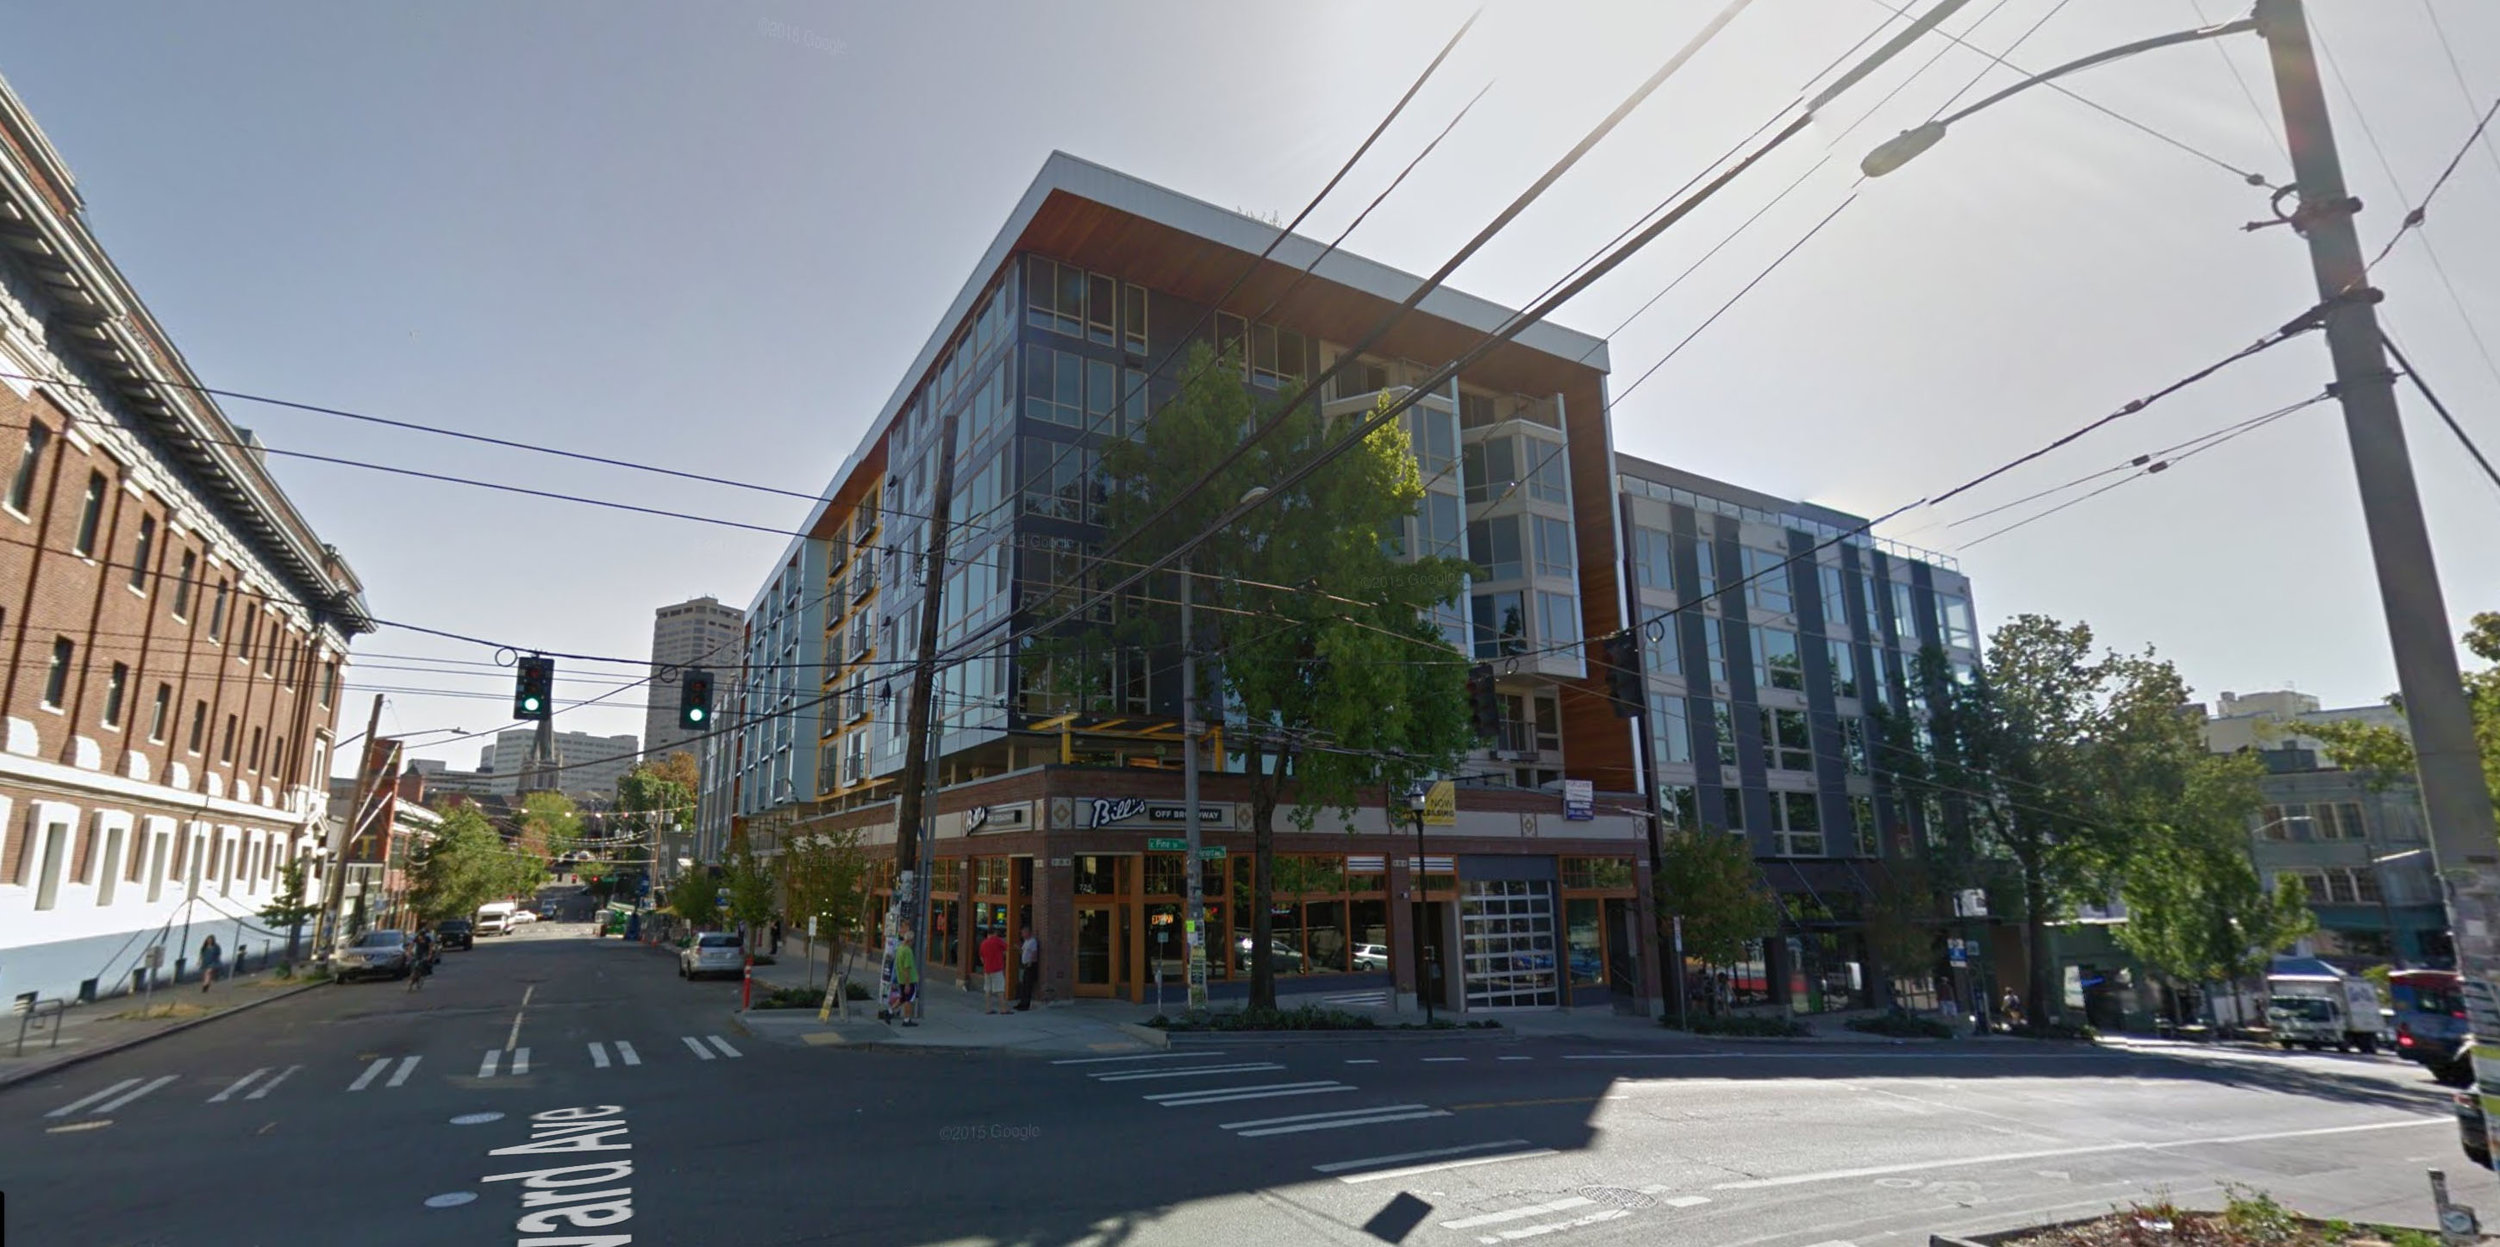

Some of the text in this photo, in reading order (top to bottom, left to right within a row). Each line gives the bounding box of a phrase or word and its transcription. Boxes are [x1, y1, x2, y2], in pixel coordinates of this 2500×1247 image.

[1090, 798, 1146, 829] Bill's
[1155, 810, 1219, 819] OFF BRWAY
